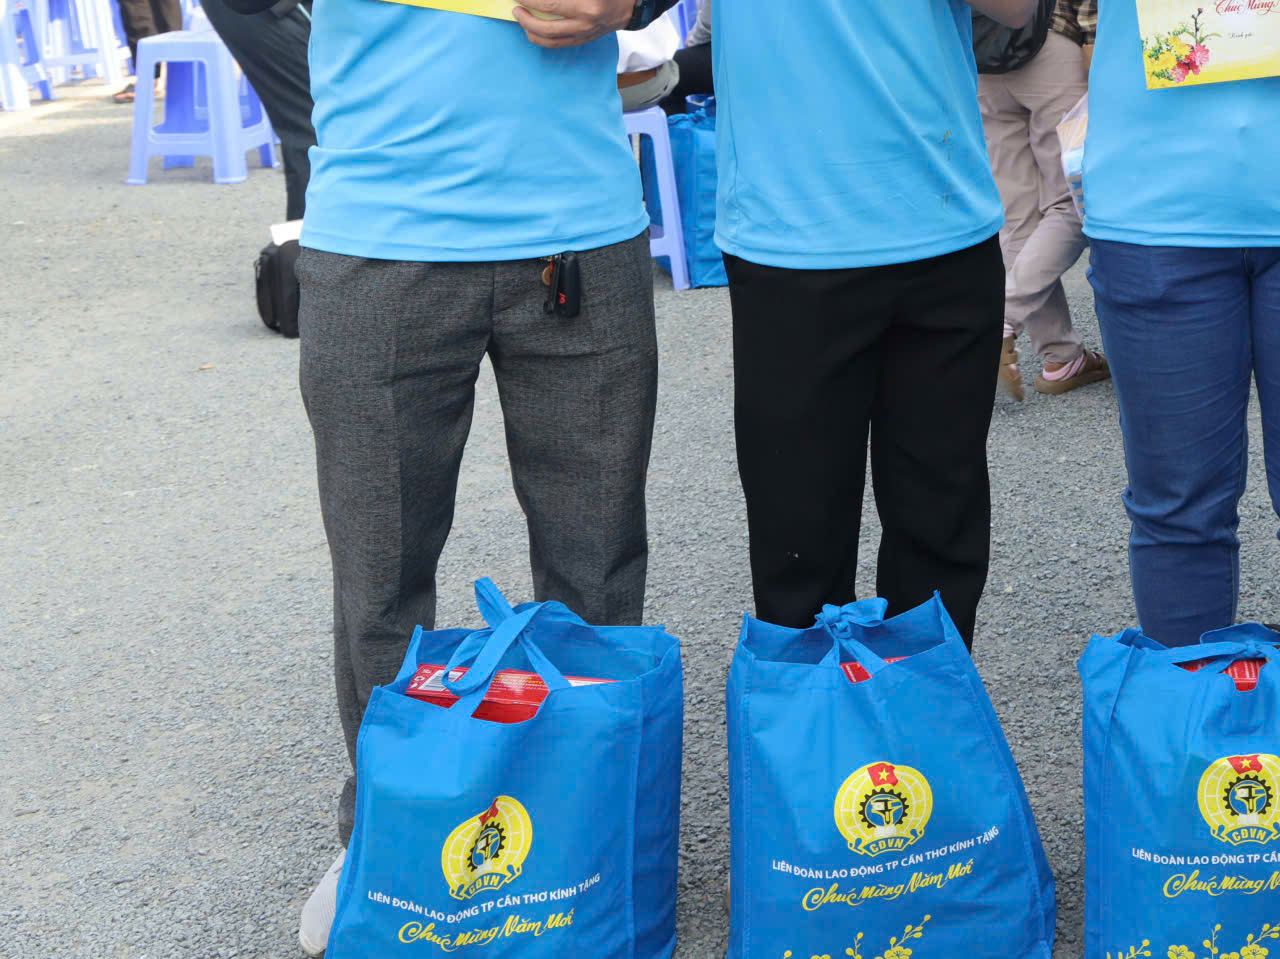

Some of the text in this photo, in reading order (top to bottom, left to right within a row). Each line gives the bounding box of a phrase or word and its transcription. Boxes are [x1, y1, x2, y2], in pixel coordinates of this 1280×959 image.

[869, 838, 904, 853] CĐVN
[1231, 828, 1267, 841] CĐVN
[772, 860, 792, 873] LIÊN
[793, 866, 823, 879] ĐOÀN
[825, 869, 848, 879] LAO
[850, 864, 883, 878] ĐỘNG
[885, 860, 899, 871] TP
[925, 846, 948, 860] THƠ
[949, 838, 974, 854] KÍNH
[976, 826, 999, 845] TẶNG
[1132, 848, 1152, 862] LIÊN
[1153, 854, 1185, 865] ĐOÀN
[1187, 855, 1209, 865] LAO
[1211, 853, 1244, 866] ĐỘNG
[1246, 854, 1260, 863] TP
[368, 890, 391, 905] LIÊN
[392, 897, 422, 914] ĐOÀN
[424, 907, 445, 921] LAO
[447, 905, 479, 924] ĐỘNG
[481, 901, 494, 913] TP
[523, 891, 548, 904] THƠ
[550, 886, 577, 901] KÍNH
[578, 872, 600, 892] TẶNG
[469, 874, 500, 894] CĐVN
[802, 858, 974, 911] Chúc Mừng Năm Mới
[1163, 869, 1223, 898] Chúc
[1217, 875, 1264, 894] Mừng
[398, 907, 575, 952] Chúc Mừng Năm Mới
